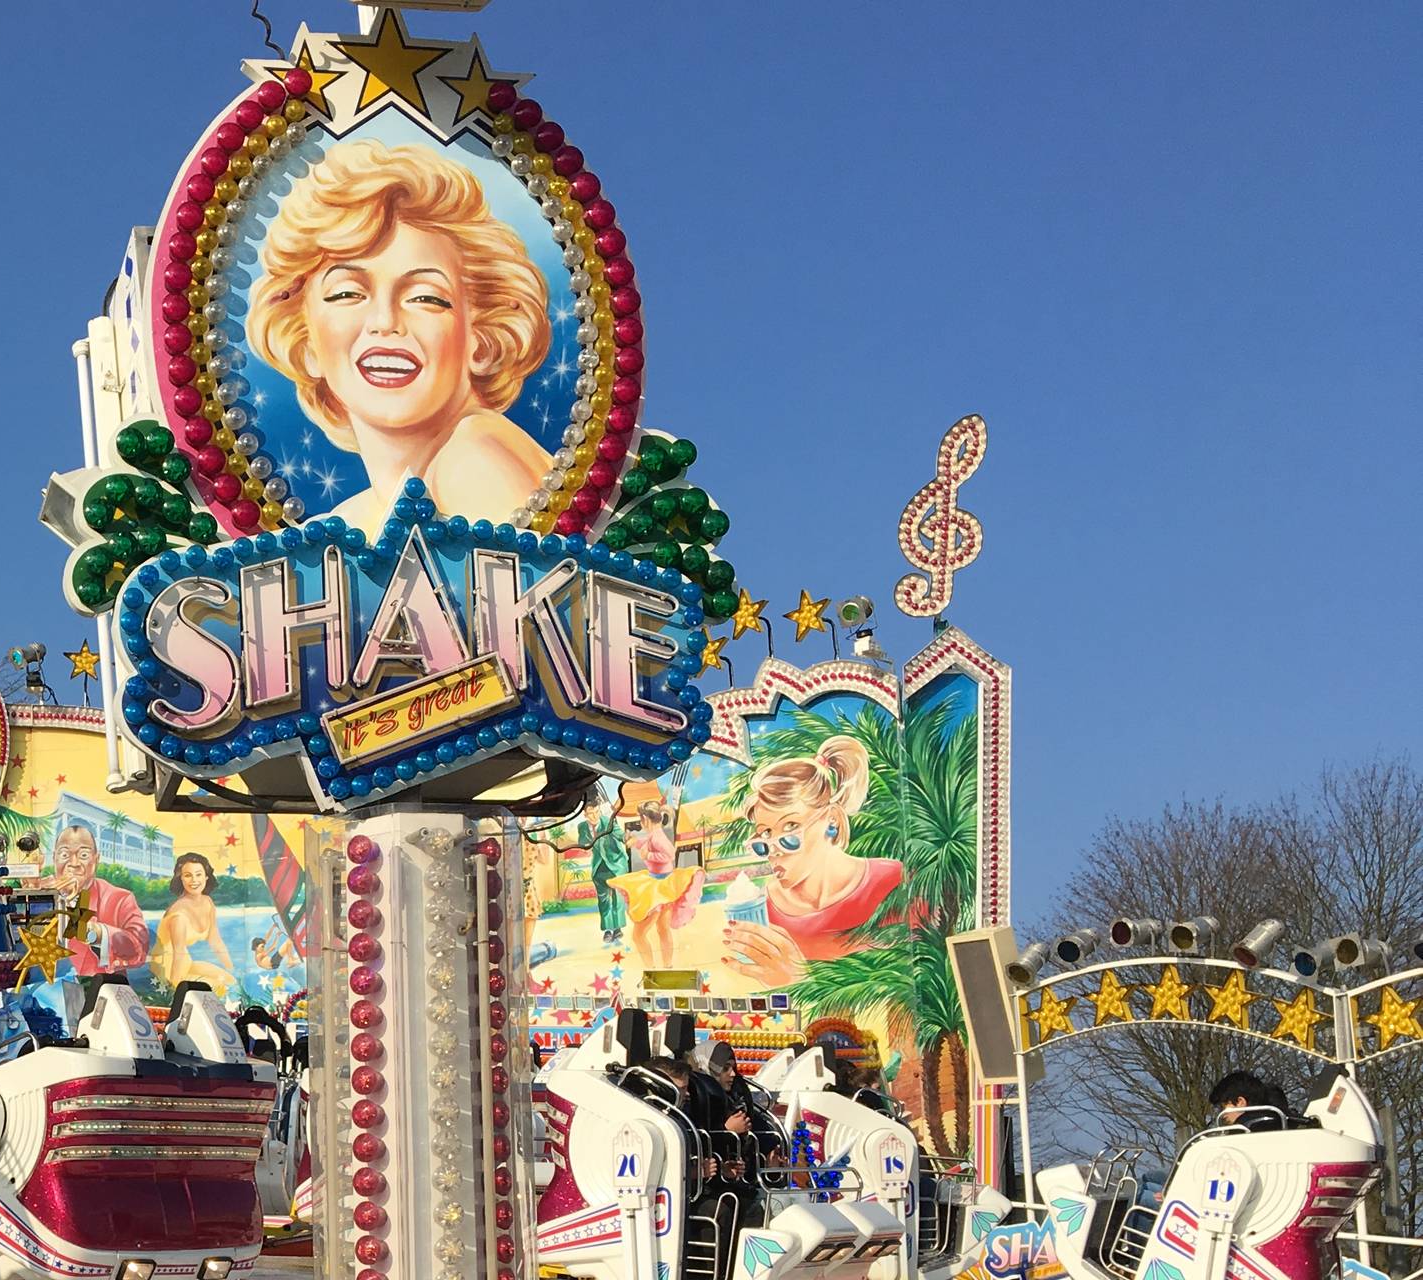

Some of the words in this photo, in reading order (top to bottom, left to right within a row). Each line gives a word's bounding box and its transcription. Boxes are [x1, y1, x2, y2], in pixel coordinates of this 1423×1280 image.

[146, 524, 688, 731] SHAKE
[342, 709, 398, 750] it's
[407, 670, 485, 731] great
[128, 1005, 152, 1038] S
[214, 1013, 237, 1045] S
[616, 1153, 642, 1178] 20
[1208, 1179, 1235, 1203] 19
[989, 1230, 1057, 1269] SHA
